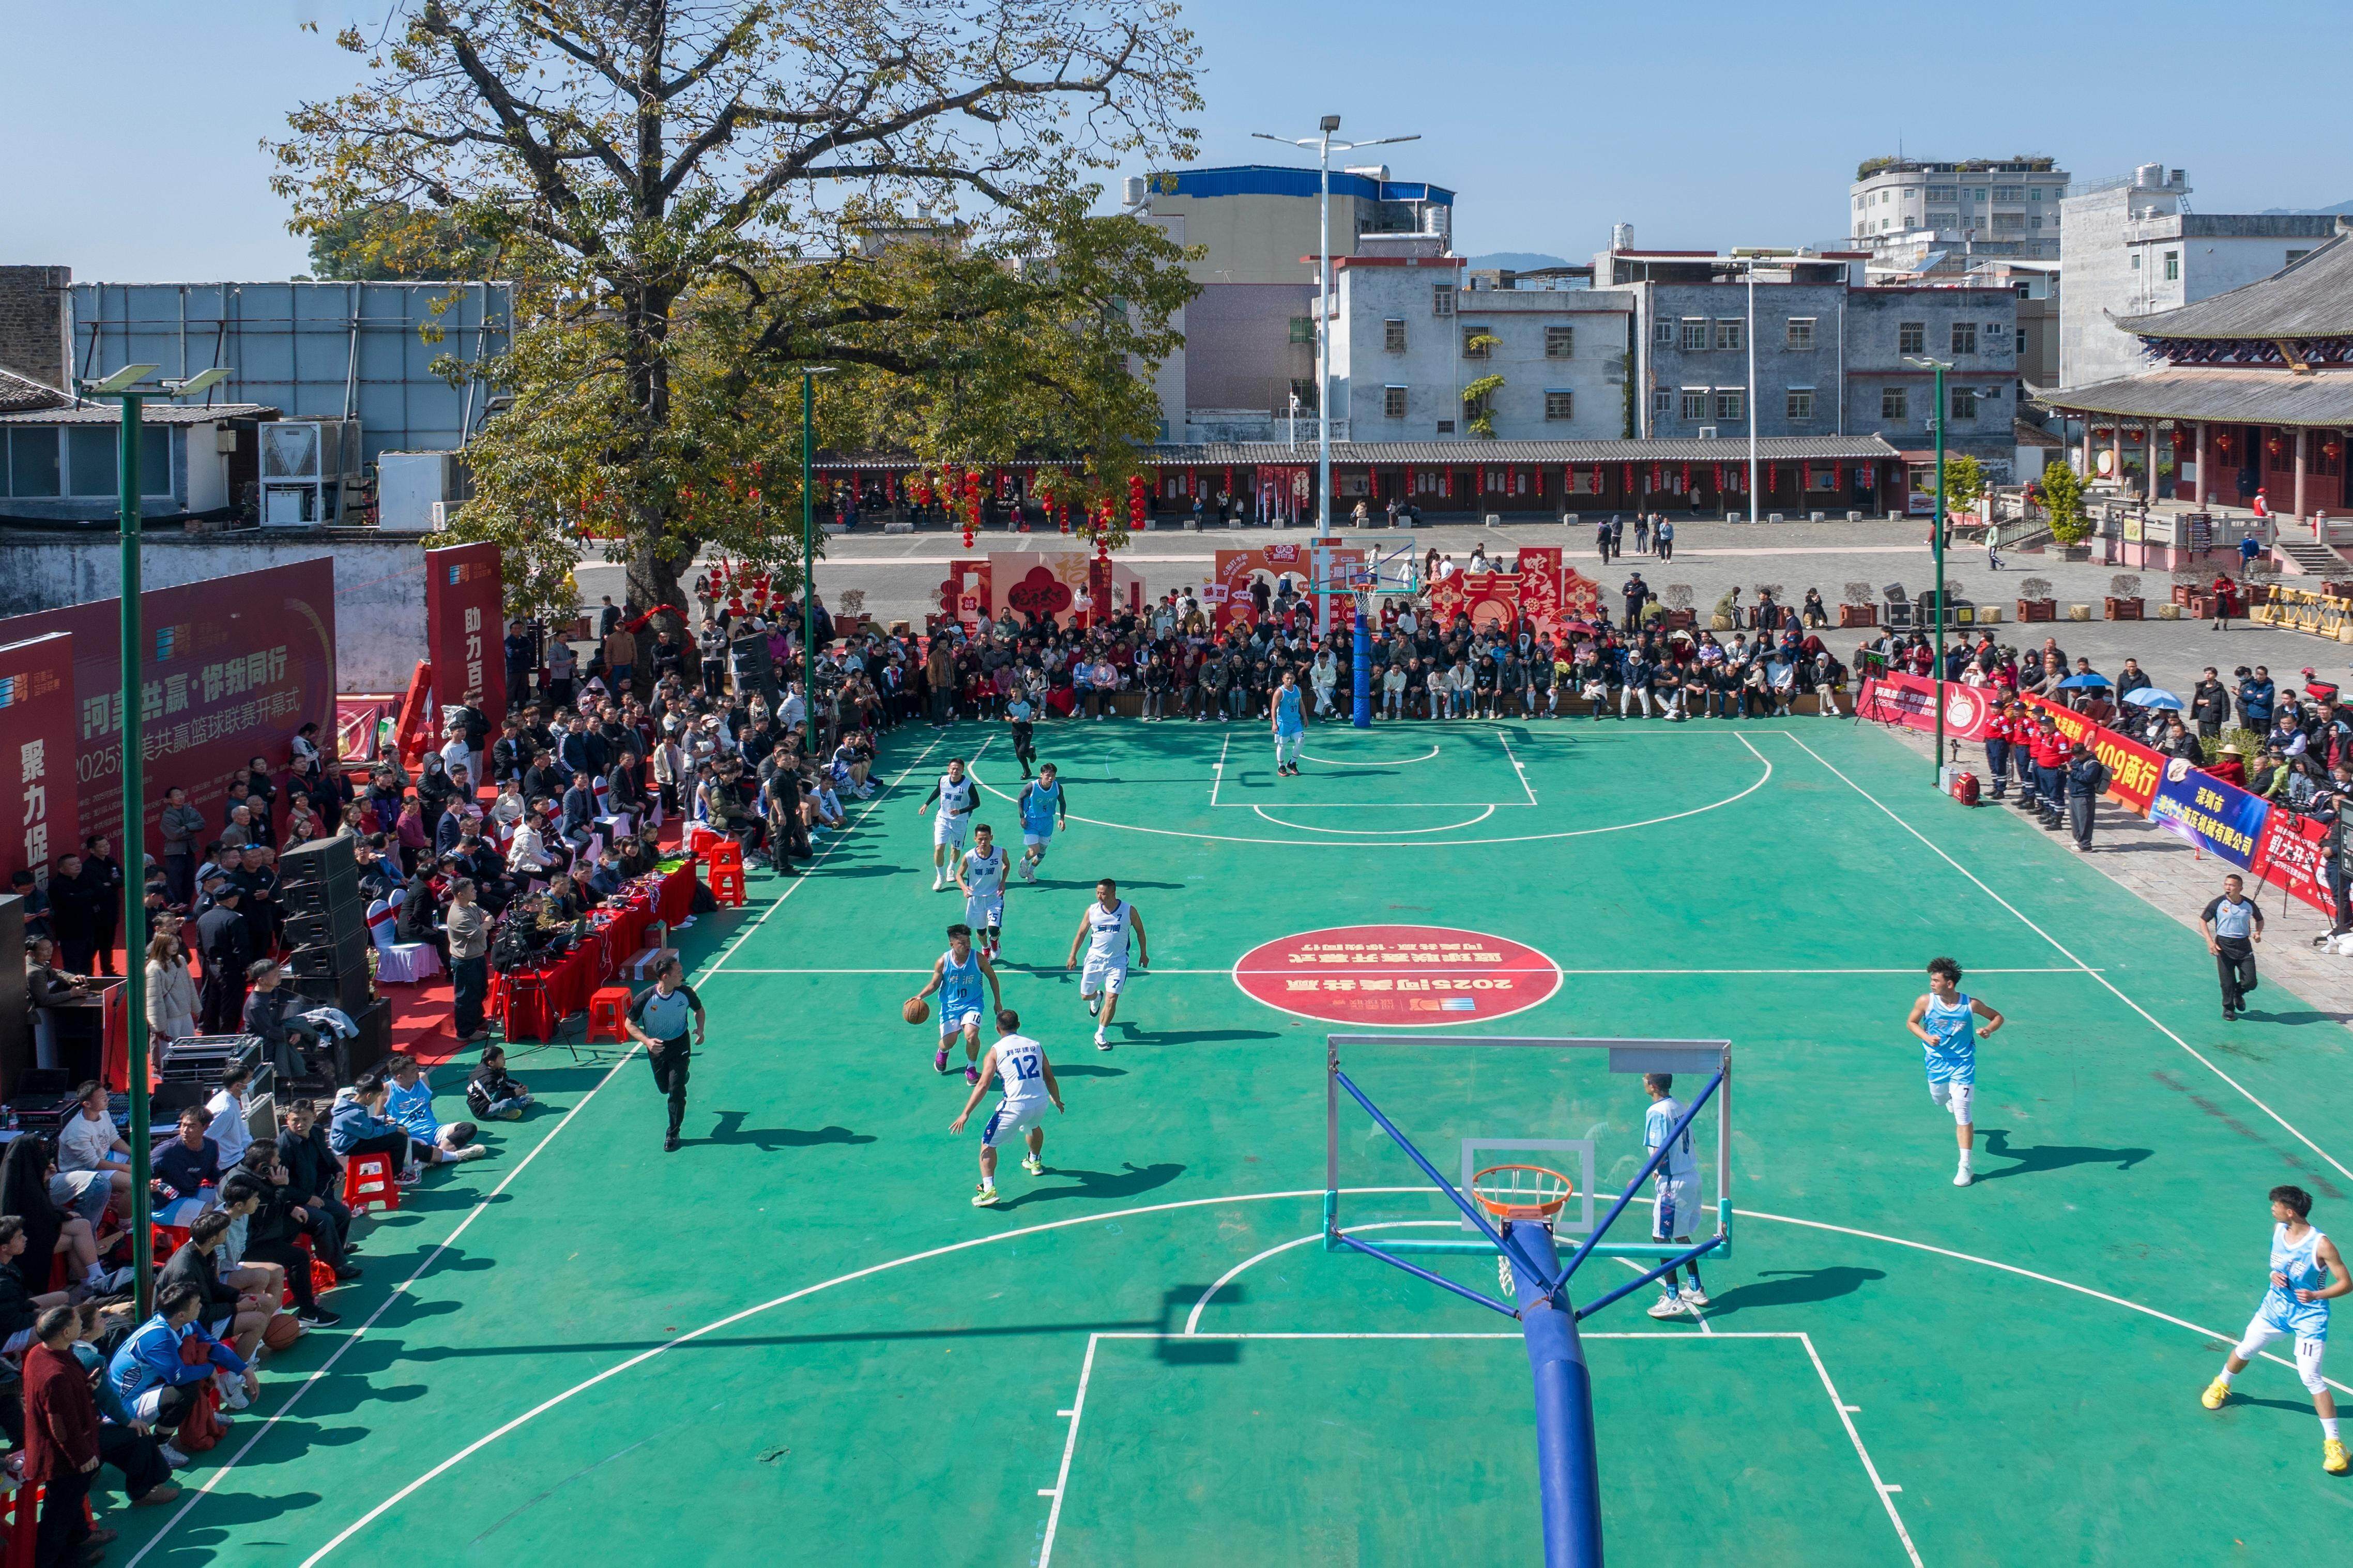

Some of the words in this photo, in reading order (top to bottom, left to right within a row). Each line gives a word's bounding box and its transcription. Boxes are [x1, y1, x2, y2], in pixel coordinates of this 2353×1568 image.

[76, 686, 300, 785] 025美共赢篮球联赛开幕式
[2195, 786, 2225, 813] 深圳市
[2268, 834, 2316, 873] 盛大开业
[1117, 914, 1122, 922] 7
[1288, 952, 1503, 963] 篮球联赛开幕式
[1112, 978, 1120, 988] 7
[1286, 978, 1514, 992] 2025河美共赢
[957, 988, 967, 998] 10
[972, 1014, 981, 1024] 10
[1012, 1054, 1040, 1080] 12
[1963, 1087, 1969, 1098] 7
[2303, 1342, 2313, 1357] 11
